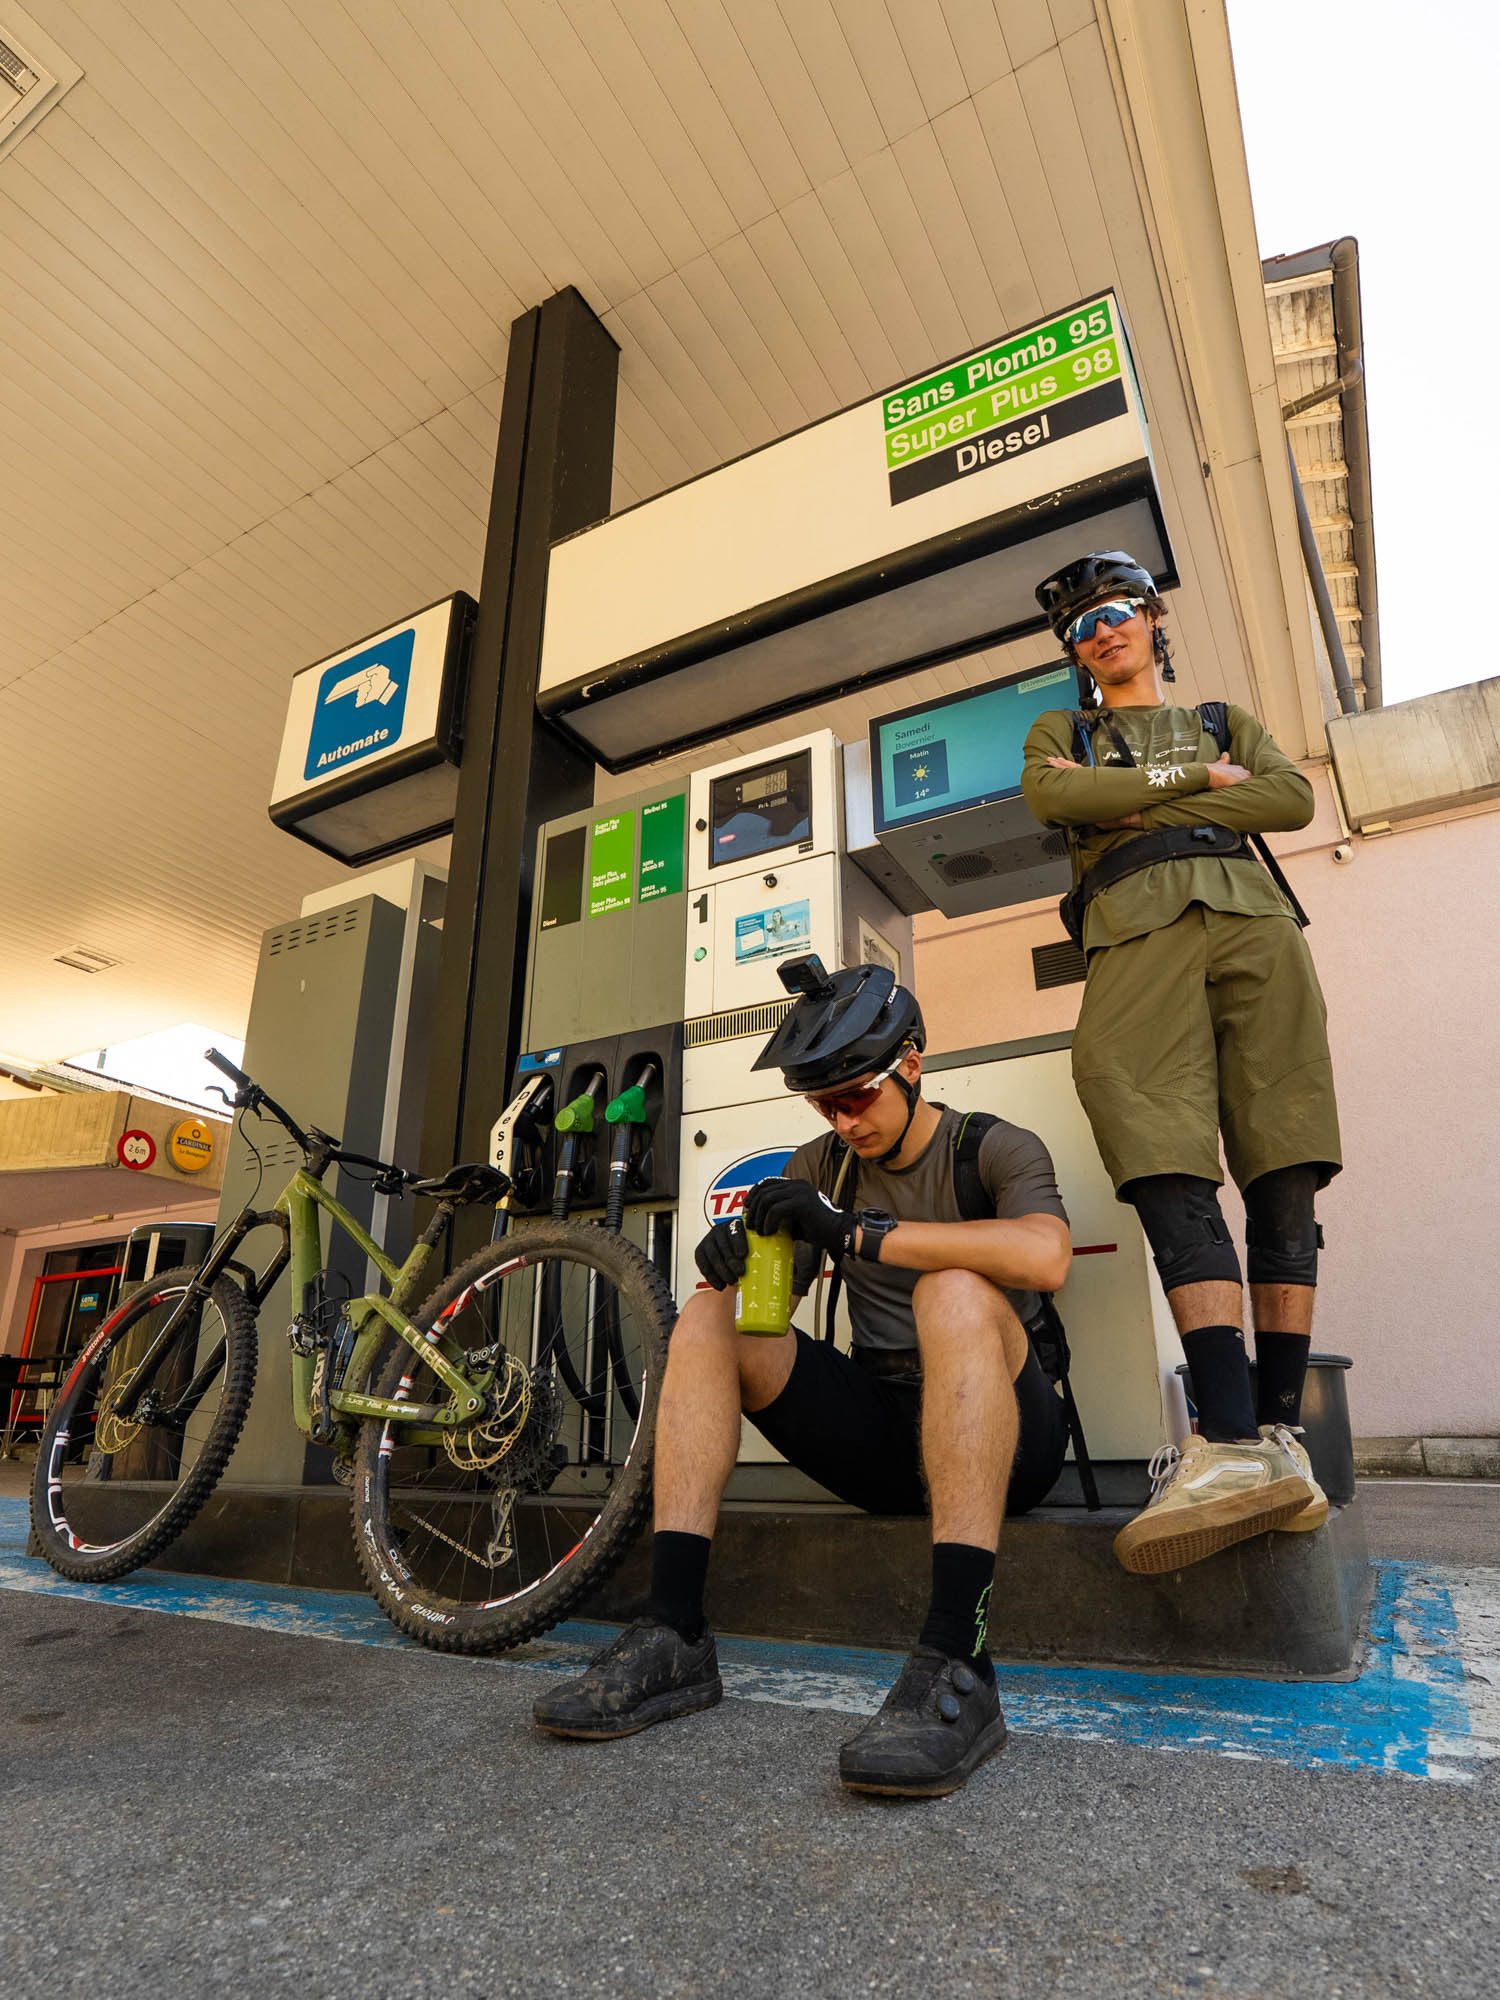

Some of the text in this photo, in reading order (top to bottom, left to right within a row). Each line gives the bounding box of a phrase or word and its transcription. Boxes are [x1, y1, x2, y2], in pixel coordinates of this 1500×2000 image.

[886, 310, 1107, 425] Sans Plomb 95
[890, 348, 1113, 458] Super Plus 98
[956, 414, 1051, 473] Diesel
[317, 728, 389, 768] Automate
[895, 722, 930, 740] Samedi
[910, 750, 929, 759] Matin
[693, 893, 707, 923] 1
[180, 1138, 209, 1151] CARDINAL
[402, 1325, 451, 1378] CUBE
[411, 1603, 449, 1624] vittoria
